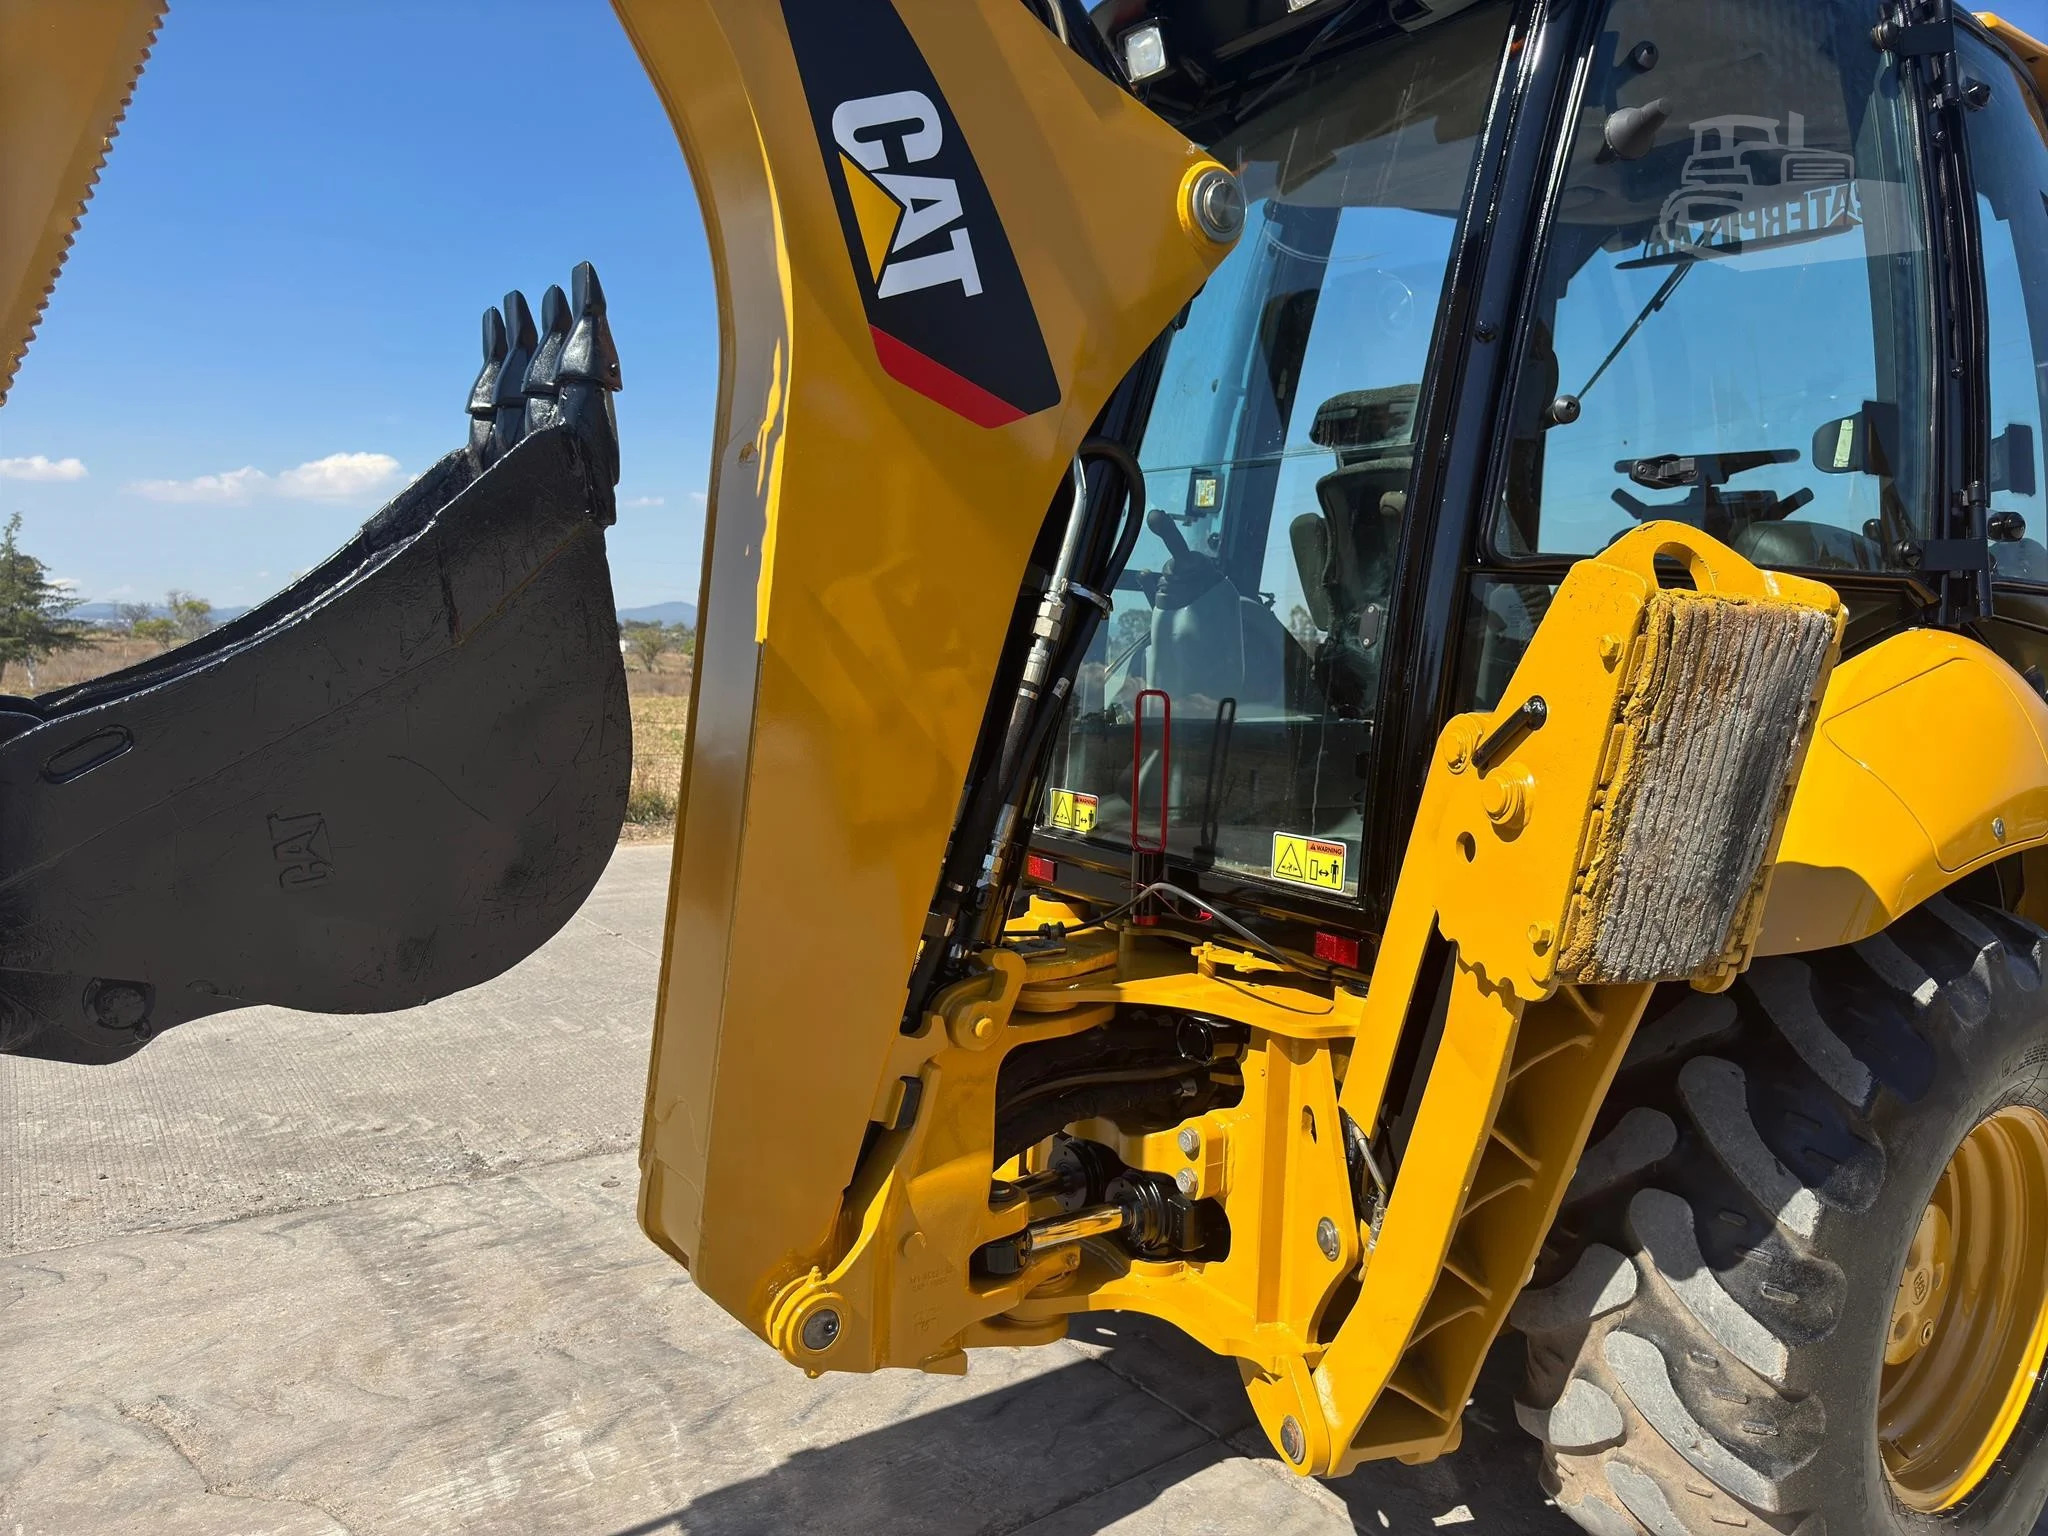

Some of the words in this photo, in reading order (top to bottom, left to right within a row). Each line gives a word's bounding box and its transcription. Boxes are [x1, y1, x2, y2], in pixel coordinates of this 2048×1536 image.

[832, 89, 983, 299] CAT
[267, 812, 334, 889] CAT
[1316, 845, 1343, 855] WARNING
